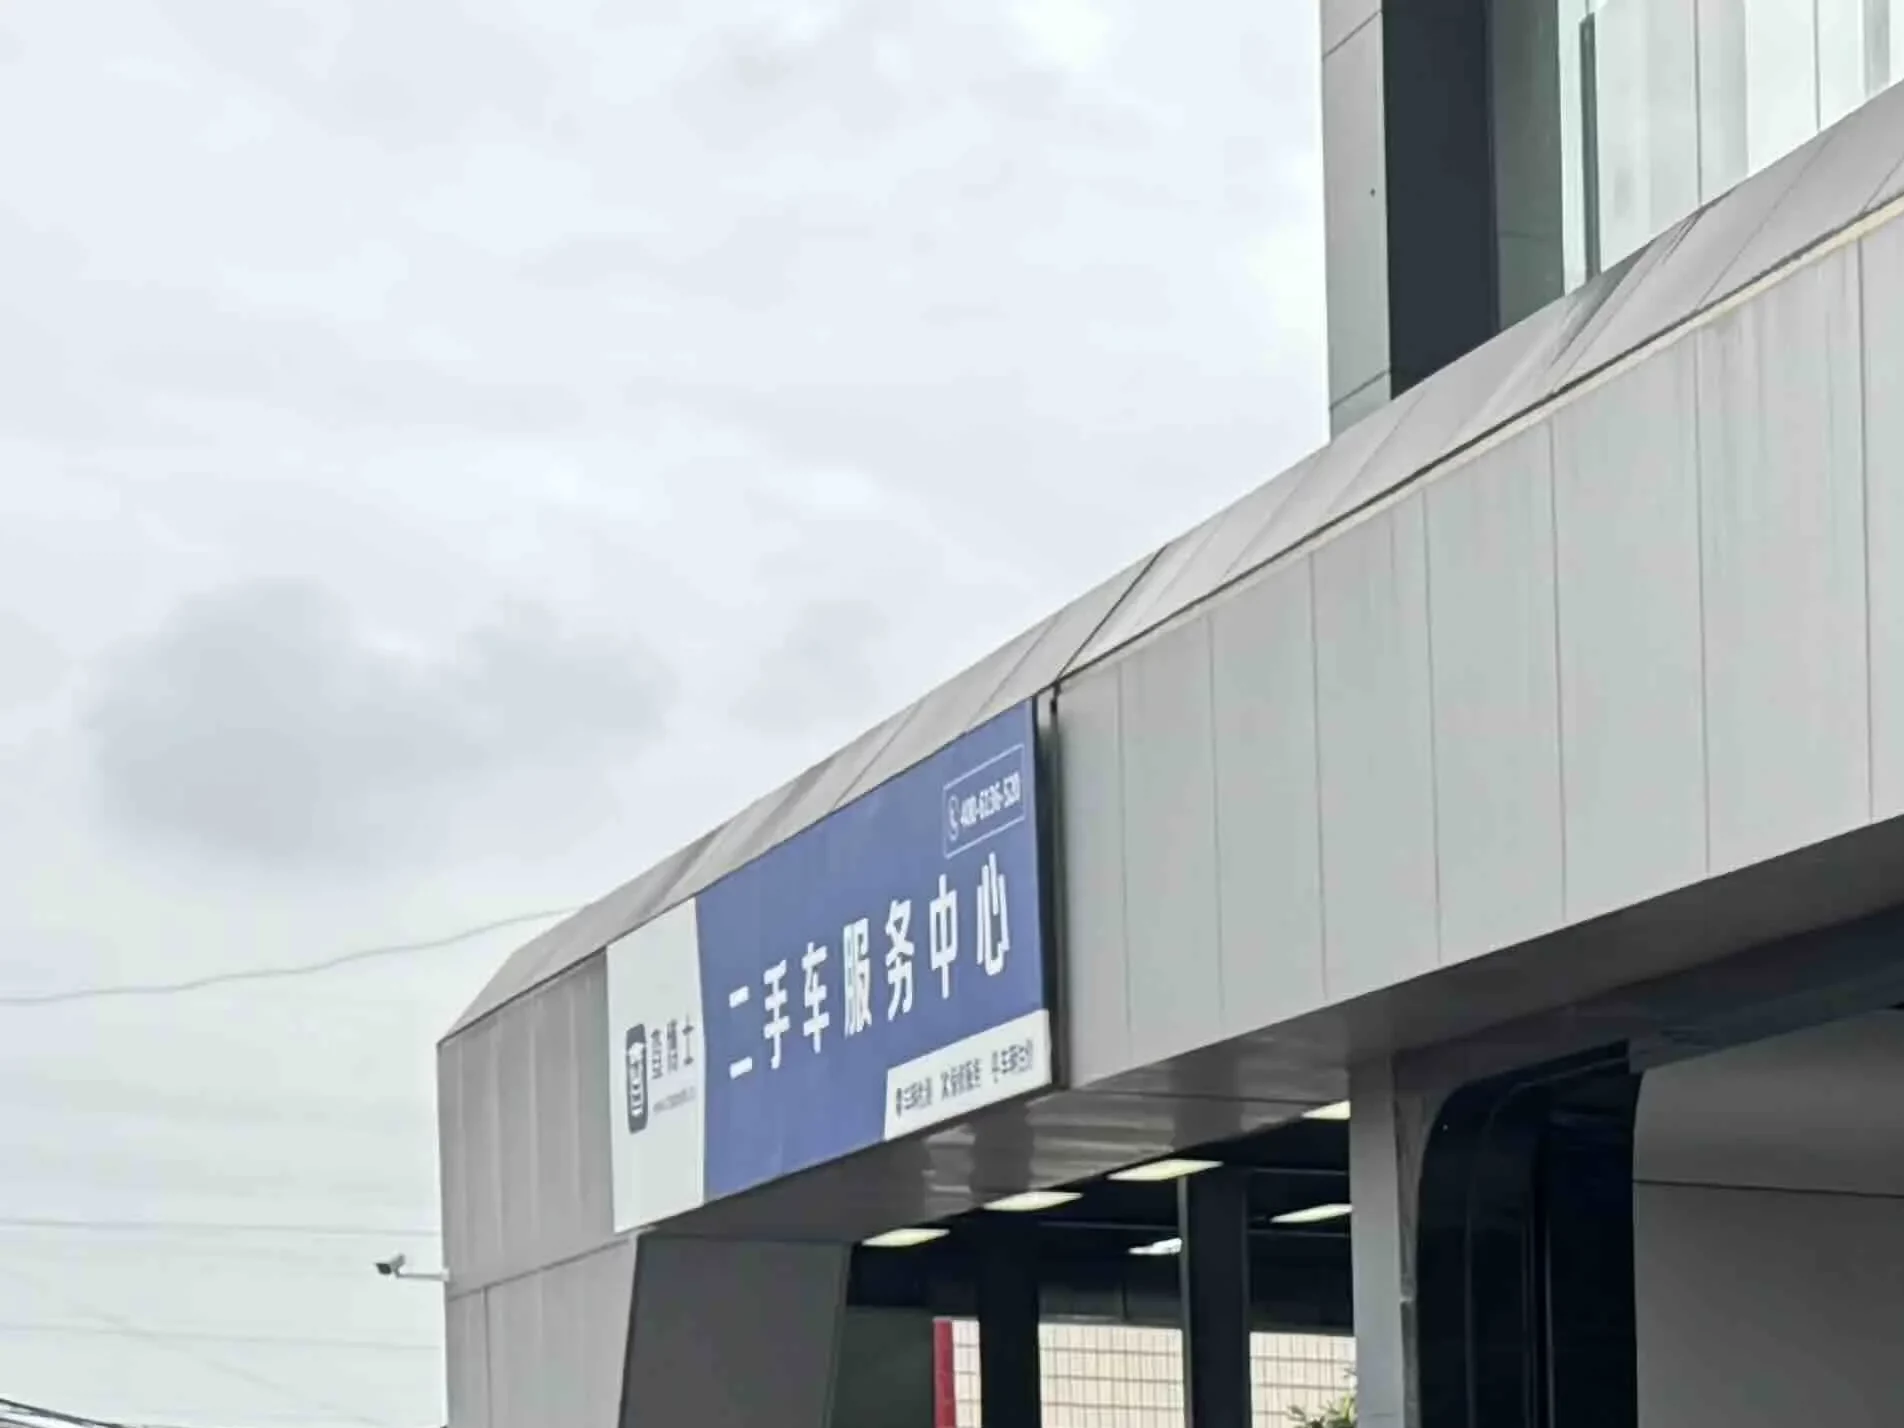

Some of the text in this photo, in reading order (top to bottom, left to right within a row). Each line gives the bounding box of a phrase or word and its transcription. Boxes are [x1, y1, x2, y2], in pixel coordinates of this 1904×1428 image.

[729, 852, 1011, 1079] 二手车服务中心
